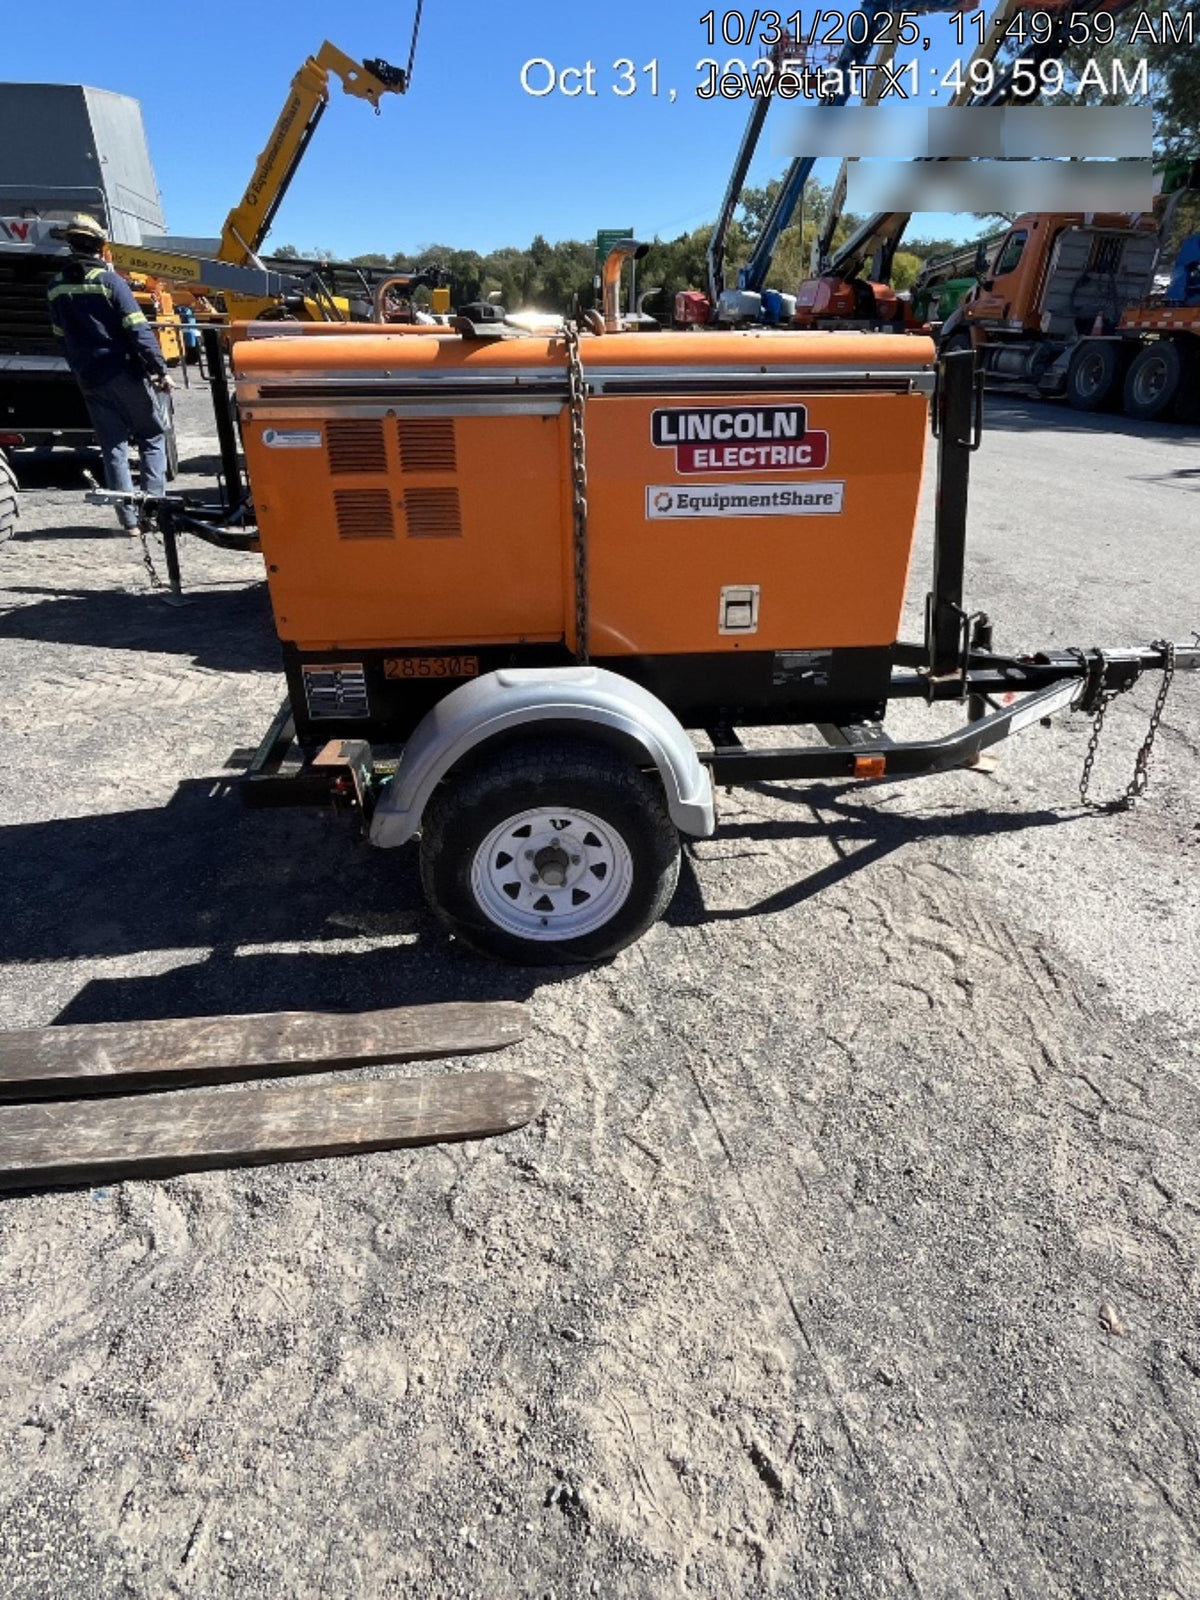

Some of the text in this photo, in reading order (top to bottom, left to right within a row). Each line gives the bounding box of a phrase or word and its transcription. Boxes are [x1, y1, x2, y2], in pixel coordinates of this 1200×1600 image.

[660, 412, 798, 442] LINCOLN
[693, 445, 812, 468] ELECTRIC
[676, 490, 834, 512] EquipmentShare
[385, 657, 477, 679] 285305
